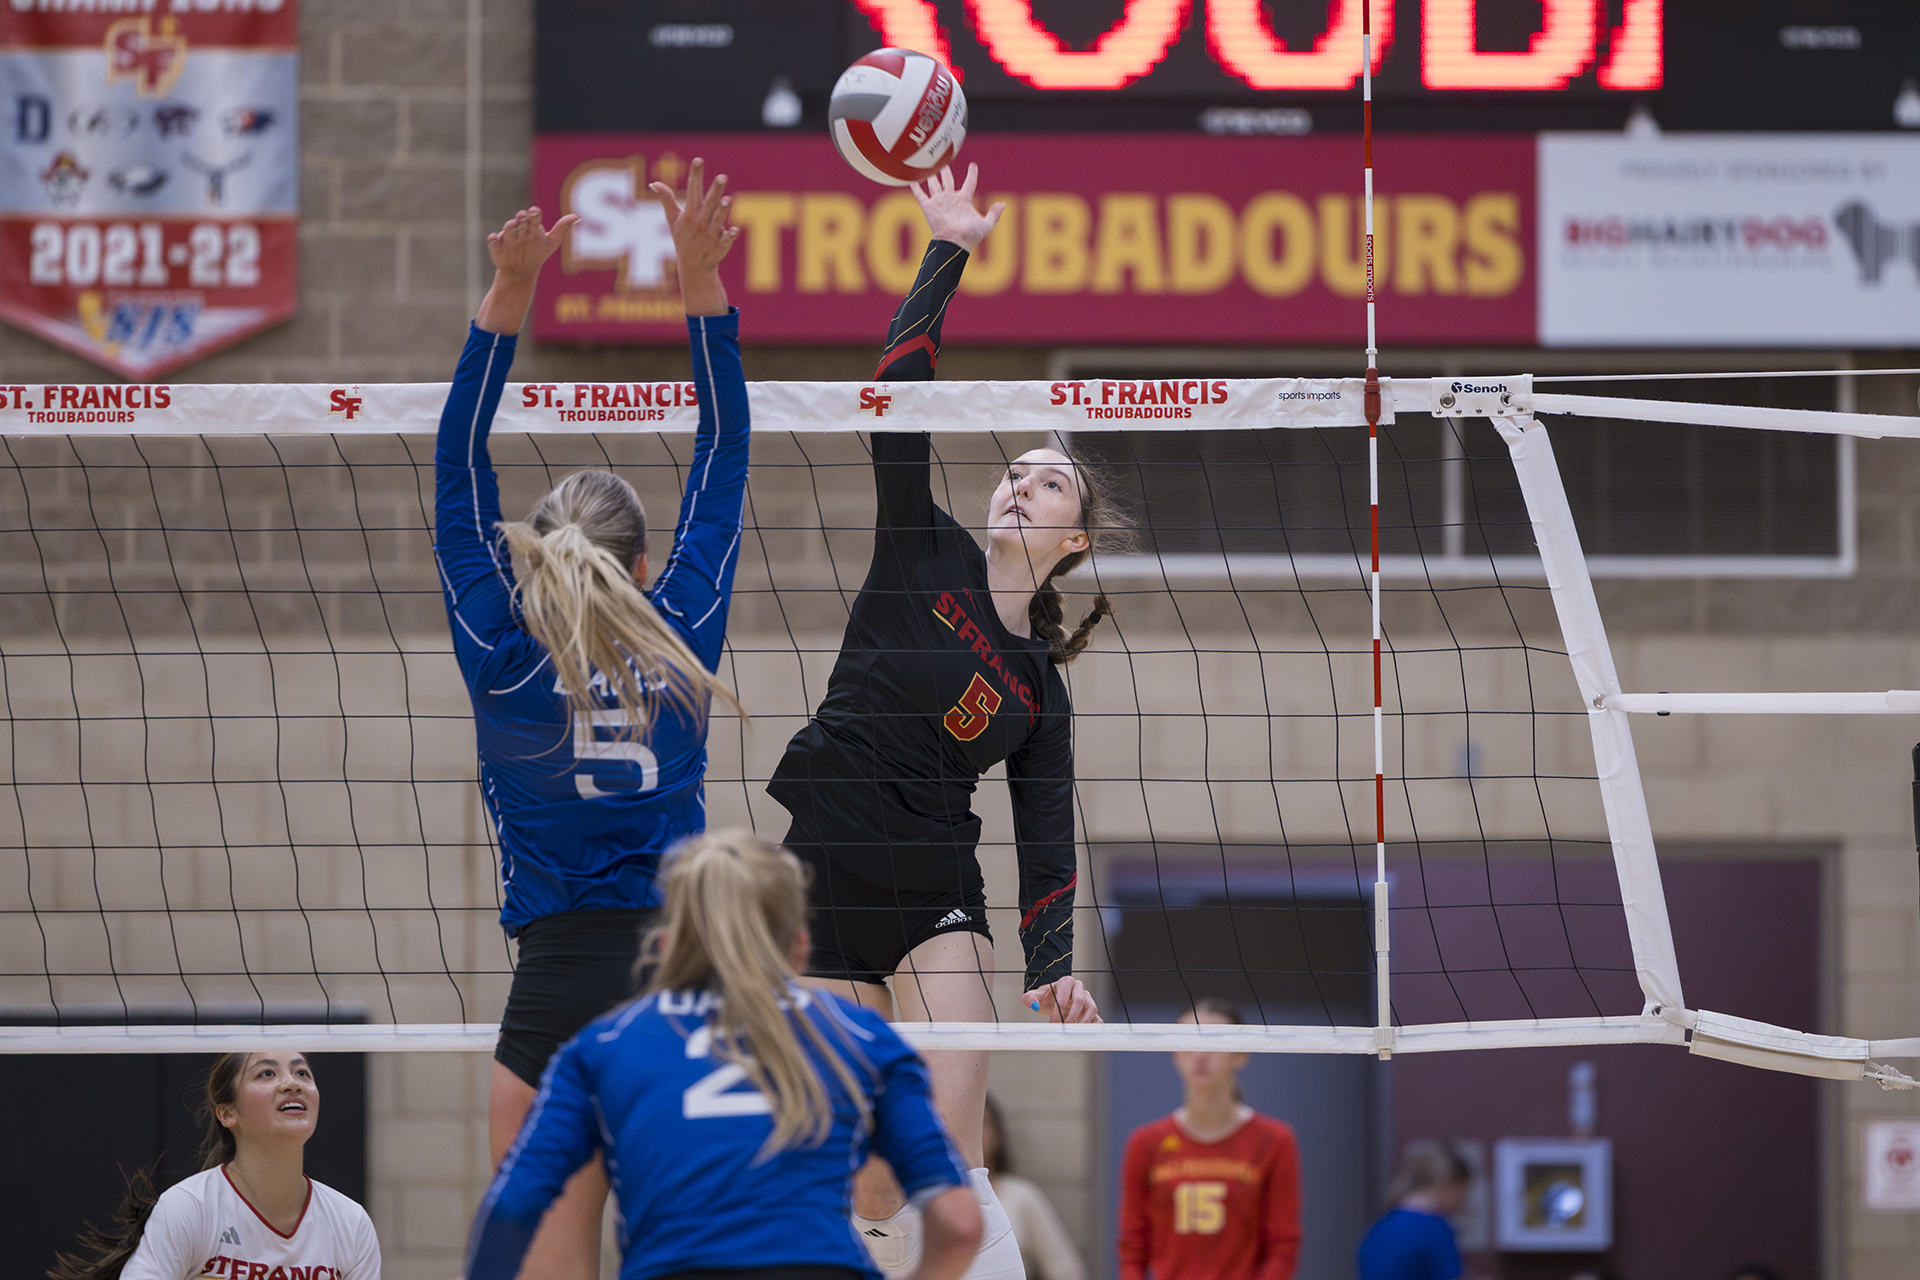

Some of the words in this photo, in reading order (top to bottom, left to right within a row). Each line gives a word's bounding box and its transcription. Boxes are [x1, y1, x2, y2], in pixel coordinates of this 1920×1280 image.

[30, 222, 262, 287] 2021-22
[731, 190, 1523, 297] TROUBADOURS
[1366, 266, 1374, 301] imports
[43, 385, 171, 409] FRANCIS
[329, 388, 364, 421] SF
[522, 384, 564, 408] ST.
[573, 383, 699, 407] FRANCIS
[859, 385, 893, 419] SF
[1050, 381, 1092, 406] ST.
[1101, 380, 1228, 405] FRANCIS
[1278, 391, 1306, 401] sports
[1306, 391, 1342, 401] imports
[1463, 383, 1508, 394] Senoh
[28, 411, 135, 424] TROUBADOURS
[558, 409, 665, 422] TROUBADOURS
[1086, 406, 1192, 419] TROUBADOURS
[943, 671, 1002, 742] 5
[573, 706, 659, 801] 5
[682, 1024, 778, 1120] 2
[1173, 1181, 1229, 1236] 15
